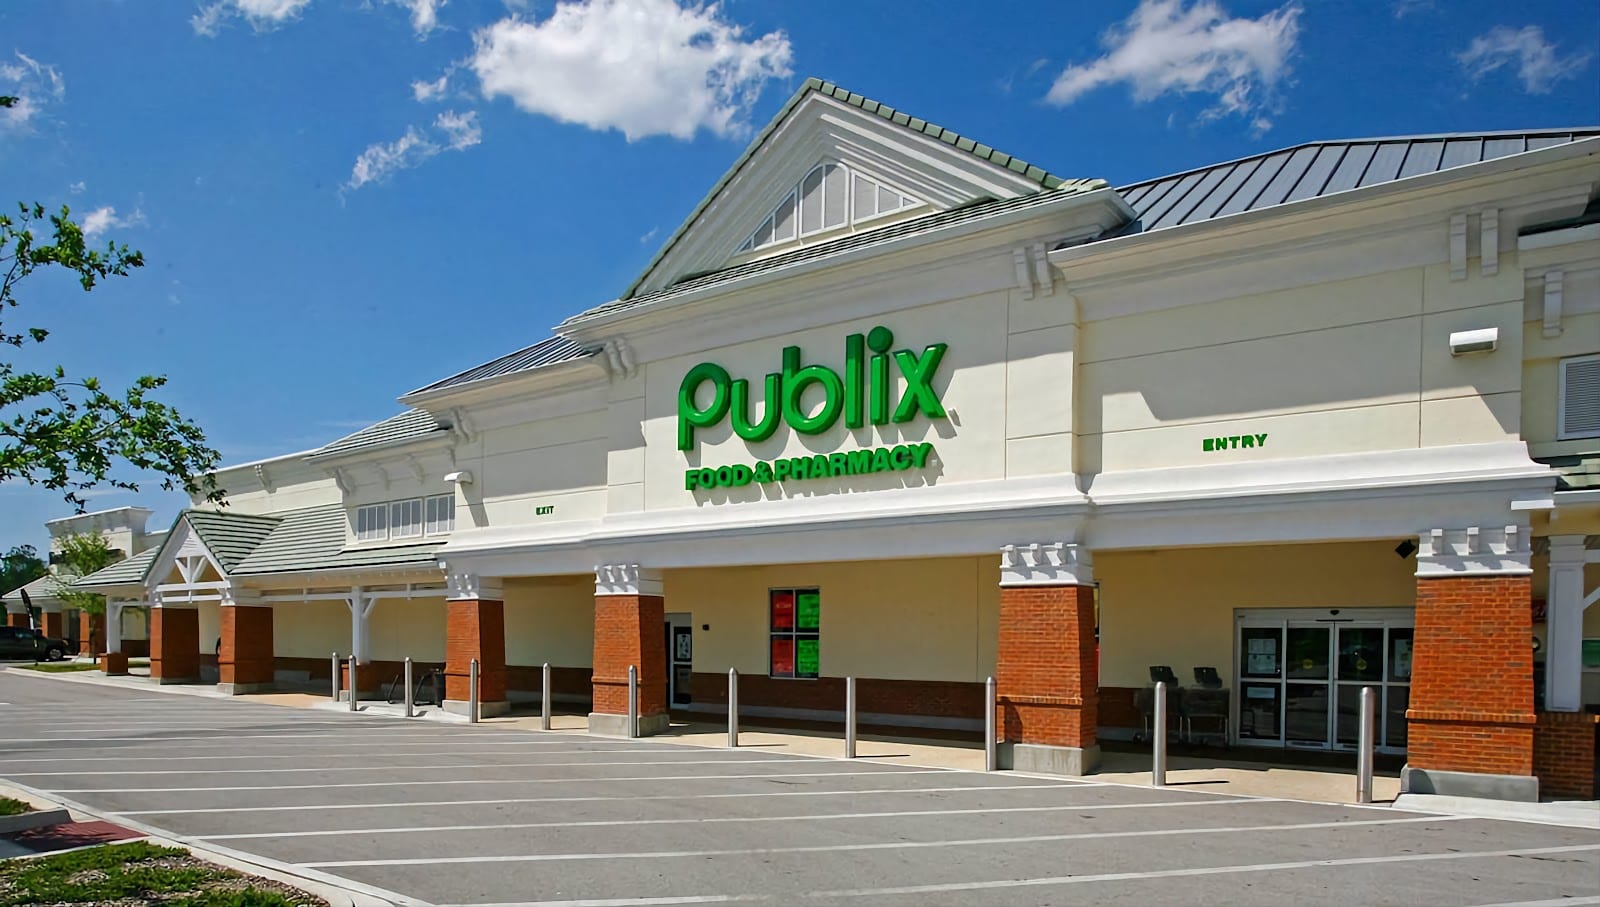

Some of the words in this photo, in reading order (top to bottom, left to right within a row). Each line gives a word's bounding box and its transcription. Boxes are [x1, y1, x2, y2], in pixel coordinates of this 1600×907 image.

[1203, 433, 1268, 452] ENTRY
[685, 464, 754, 490] FOOD
[774, 442, 934, 481] PHARMACY
[535, 505, 554, 516] EXIT
